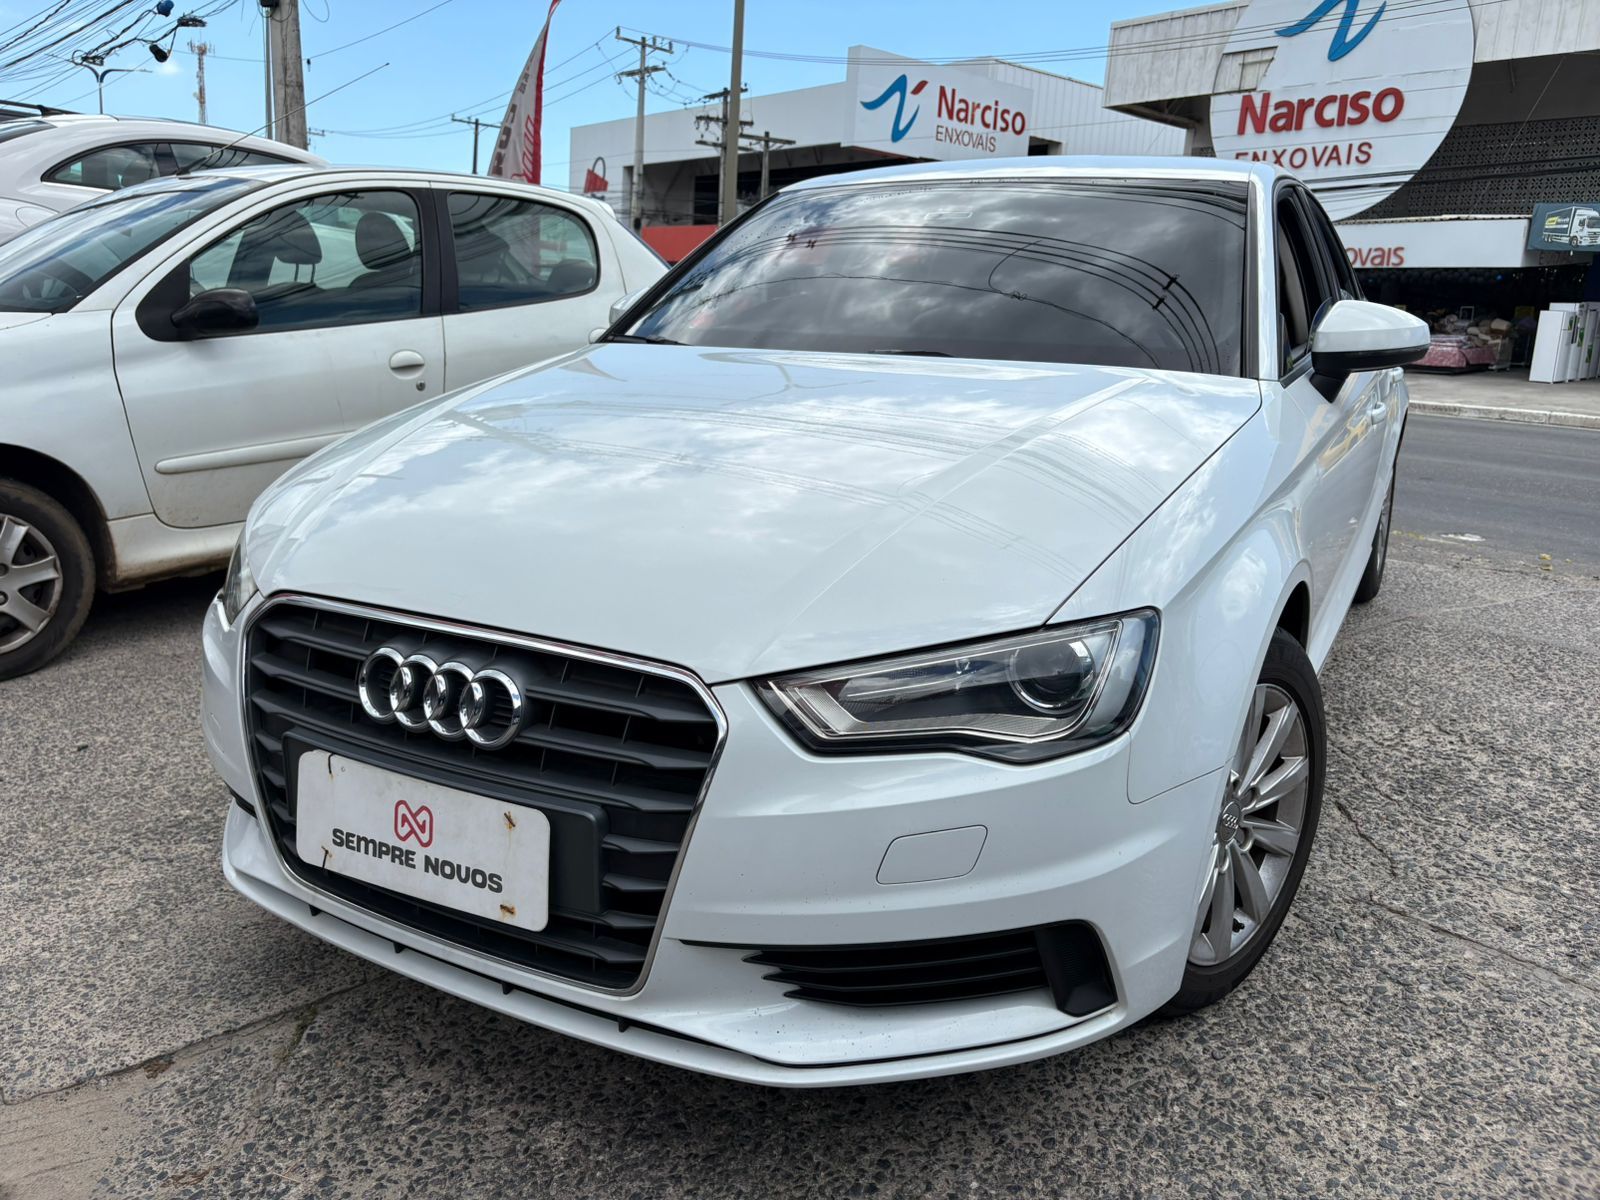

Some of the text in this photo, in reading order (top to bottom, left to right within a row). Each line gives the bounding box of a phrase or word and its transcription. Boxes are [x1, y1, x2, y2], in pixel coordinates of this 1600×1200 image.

[937, 85, 1026, 136] Narciso
[1237, 87, 1405, 136] Narciso
[935, 125, 997, 153] ENXOVAIS
[332, 828, 503, 894] SEMPRE NOVOS
